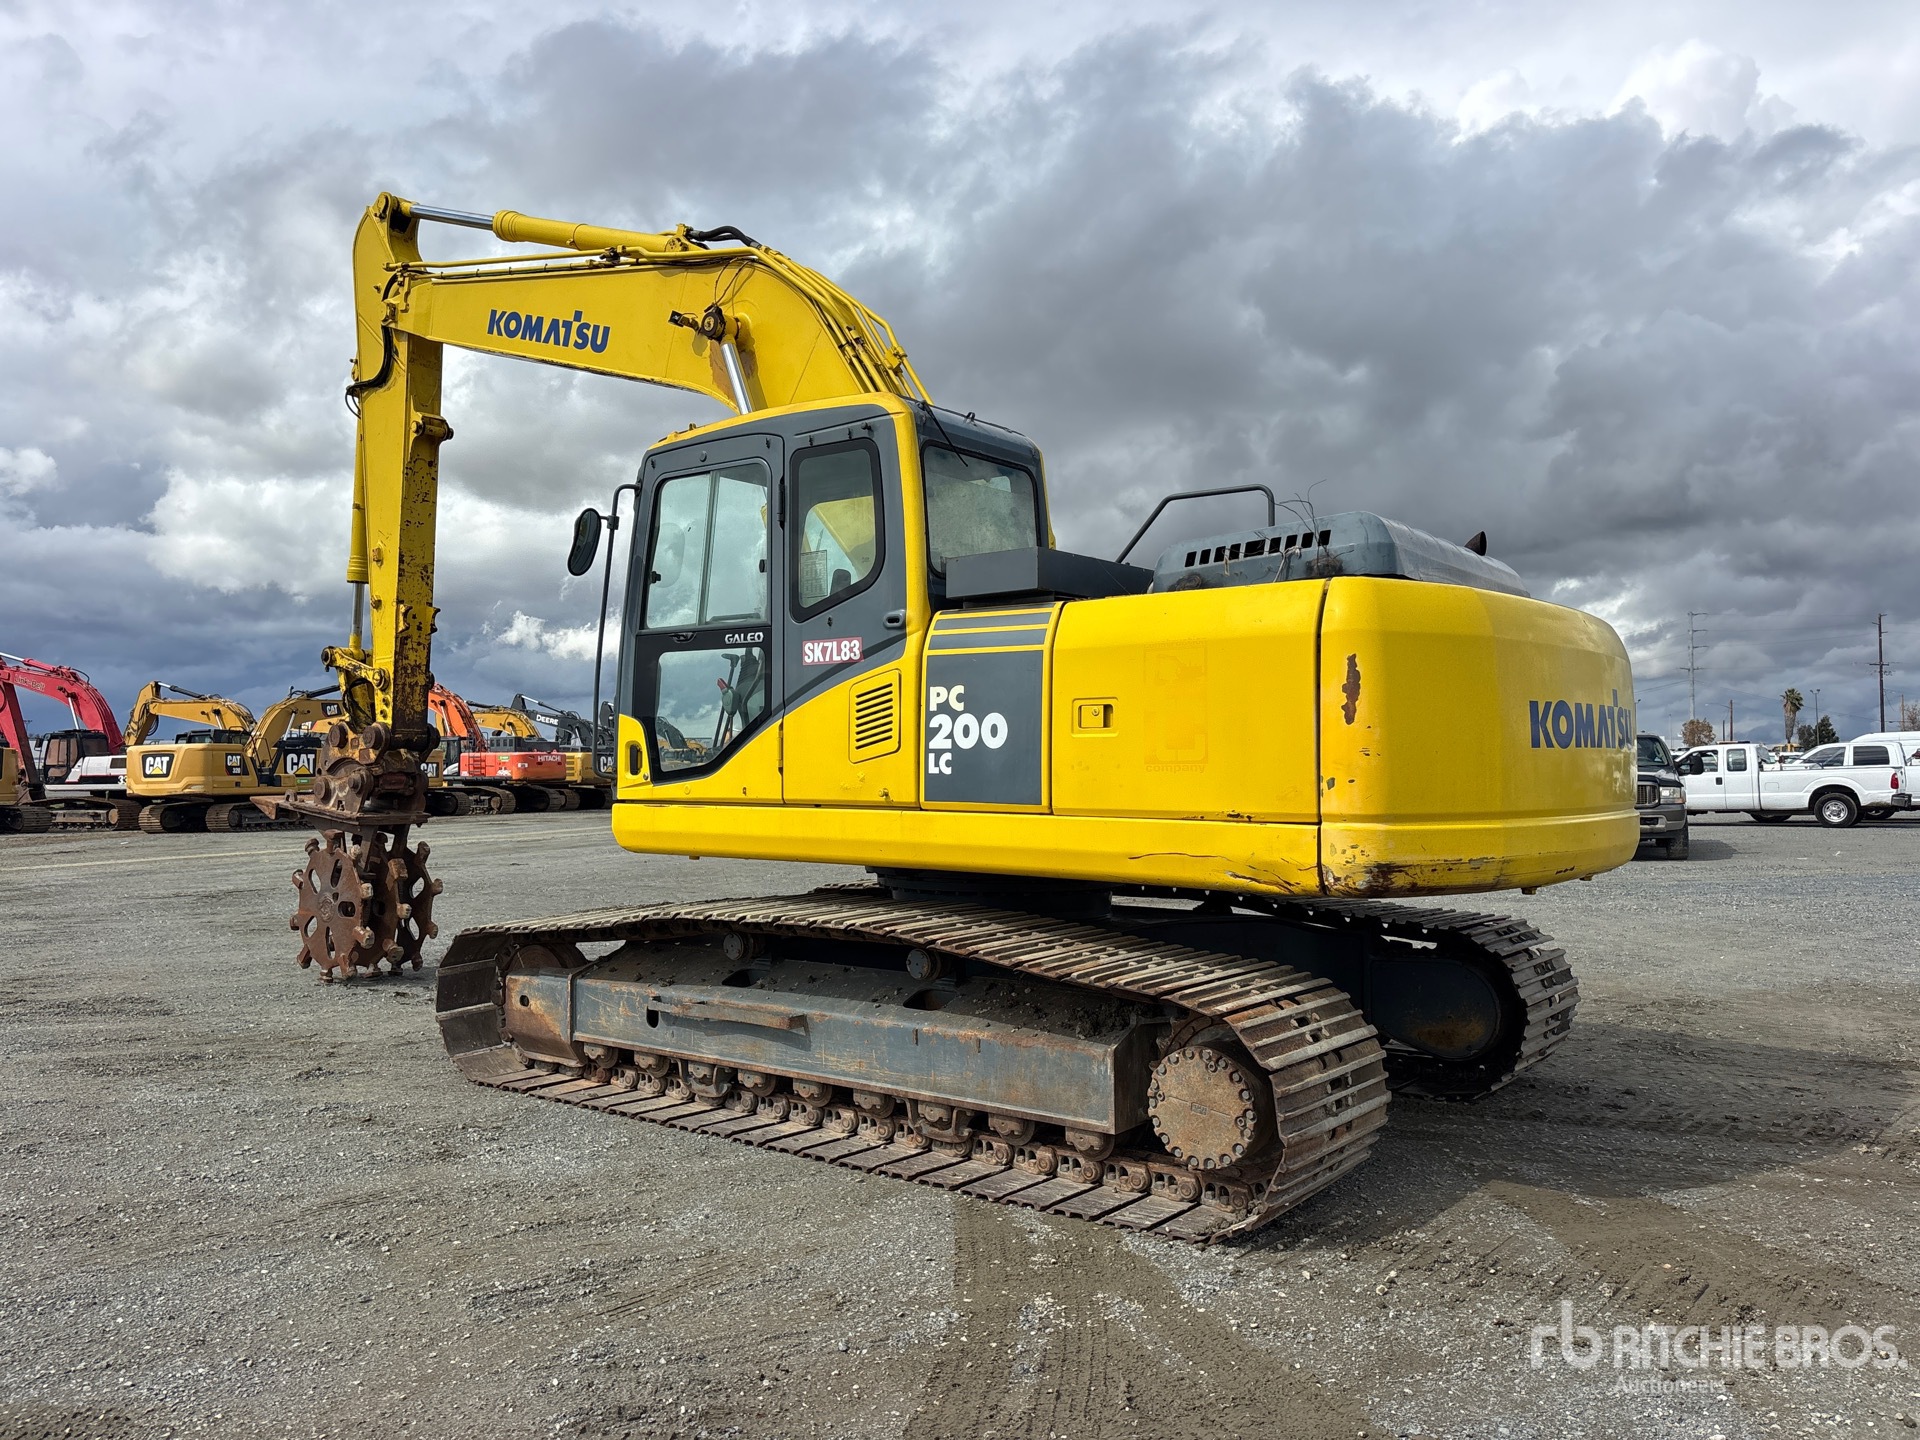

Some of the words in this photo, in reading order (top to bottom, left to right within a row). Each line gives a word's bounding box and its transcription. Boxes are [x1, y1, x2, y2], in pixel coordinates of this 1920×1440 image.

[487, 309, 611, 353] KOMATSU
[725, 632, 764, 644] GALEO
[804, 640, 860, 663] SK7L83
[929, 685, 965, 711] PC
[326, 705, 338, 715] CAT
[536, 714, 559, 725] DEERE
[1529, 689, 1633, 750] KOMATSU
[929, 712, 1009, 749] 200
[145, 756, 170, 775] CAT
[227, 755, 241, 766] CAT
[286, 753, 315, 775] CAT
[420, 763, 437, 777] CAT
[600, 756, 615, 773] CA
[928, 752, 952, 774] LC
